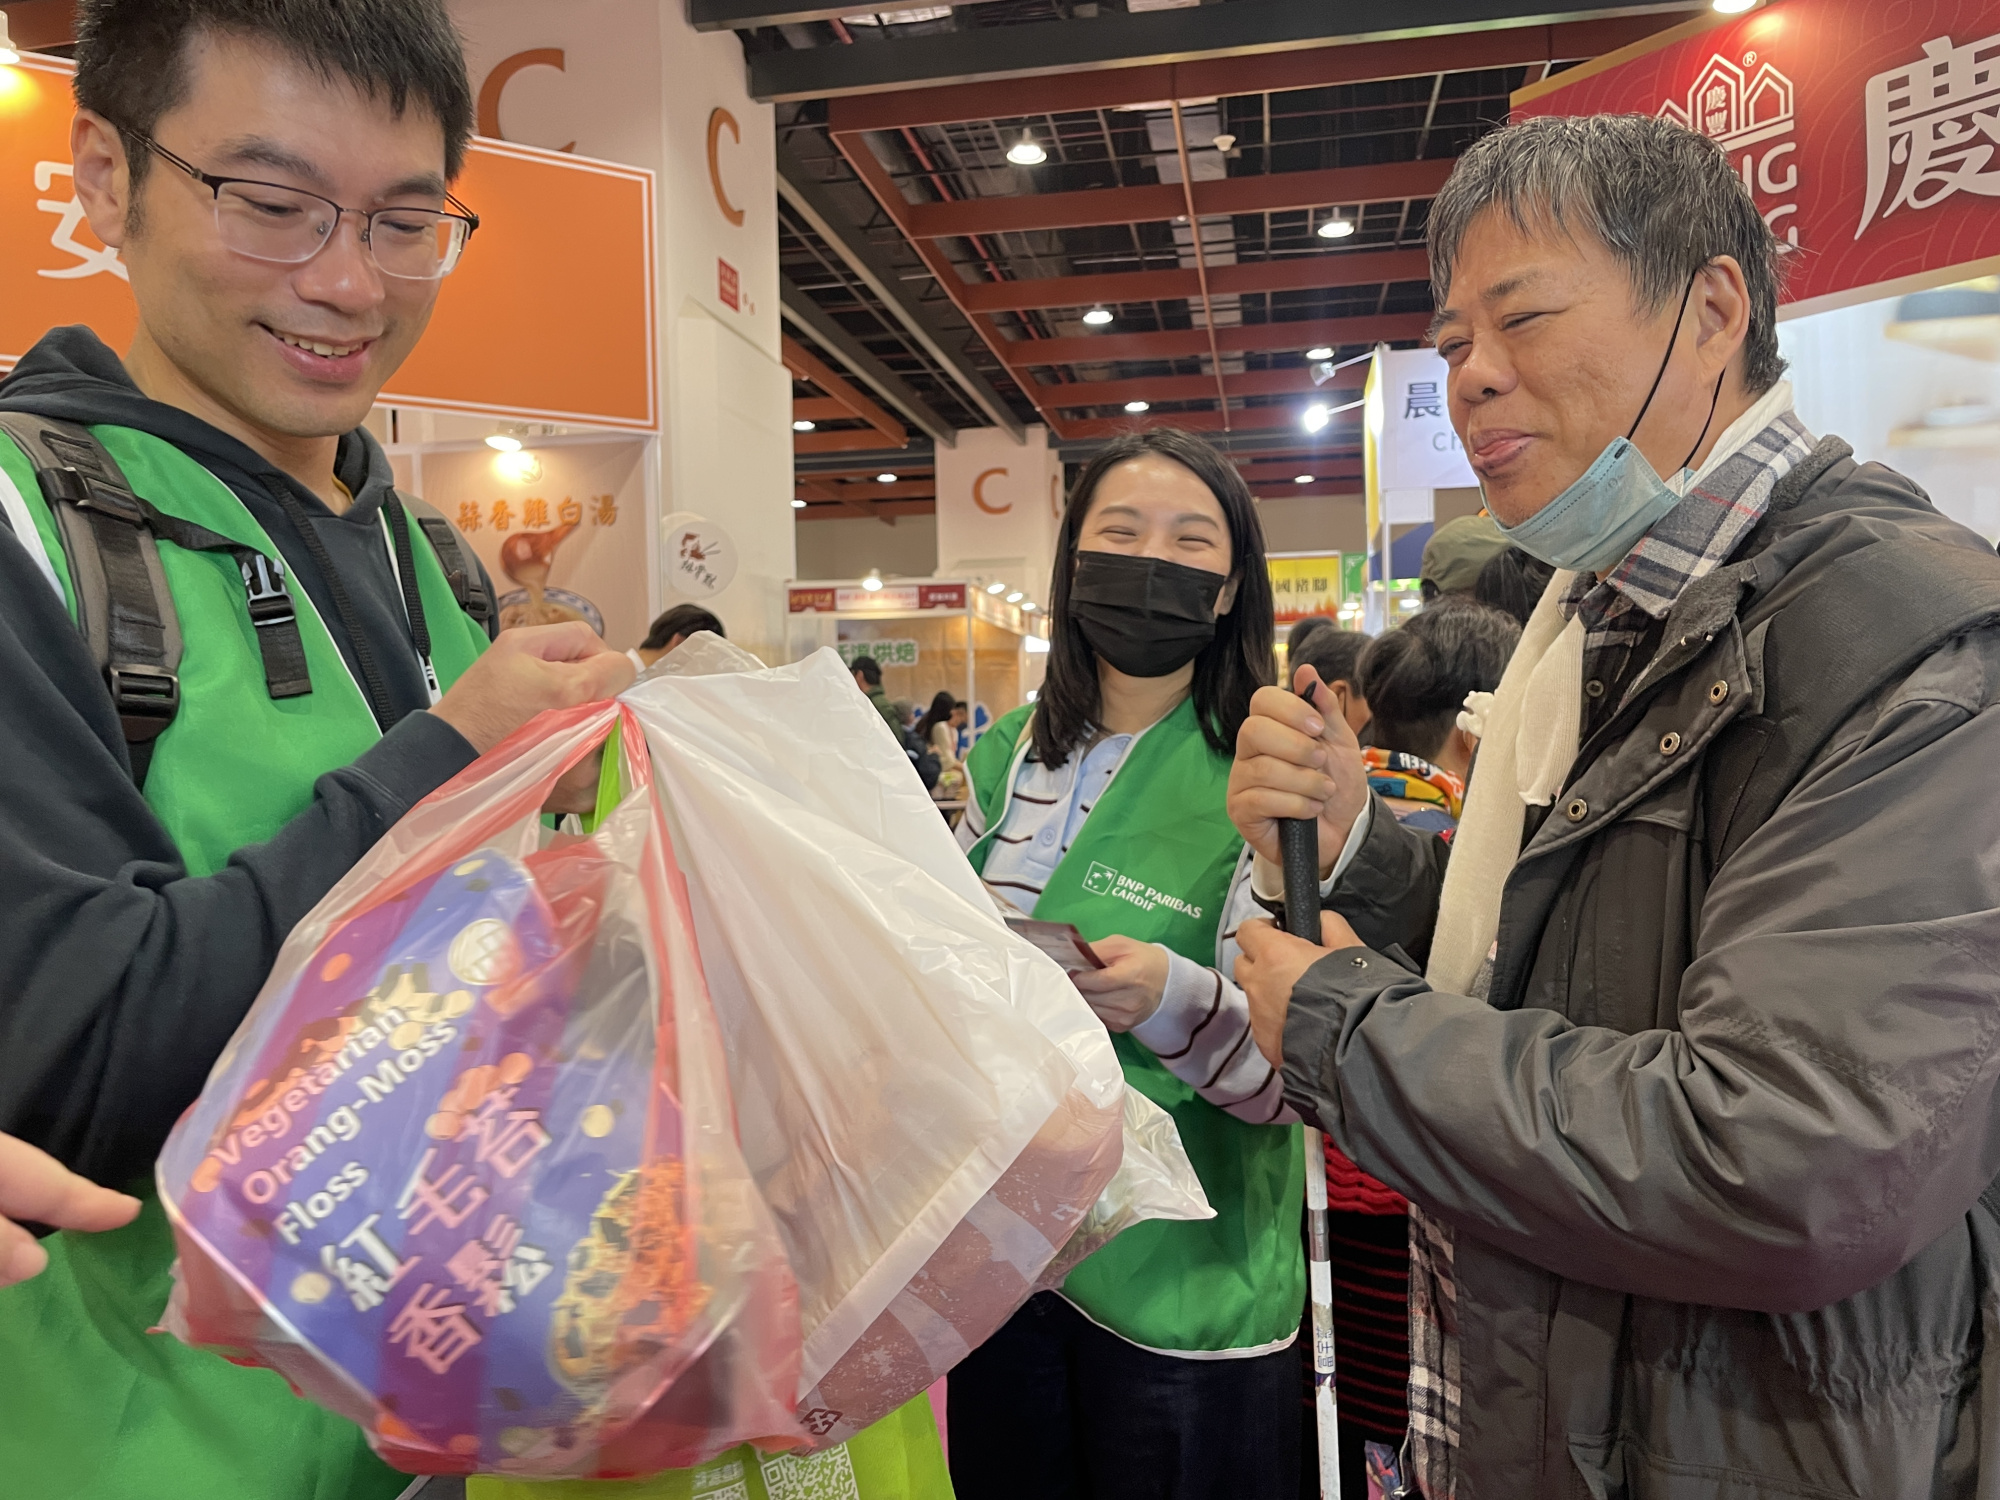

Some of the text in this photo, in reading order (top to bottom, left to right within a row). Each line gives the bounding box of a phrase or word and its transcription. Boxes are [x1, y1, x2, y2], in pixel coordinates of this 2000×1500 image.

[477, 46, 576, 154] C
[1854, 35, 2000, 241] 慶
[706, 106, 746, 228] C
[1404, 381, 1442, 420] 晨
[972, 467, 1013, 516] C
[1111, 886, 1156, 912] CARDIF
[1116, 874, 1203, 919] BNP PARIBAS
[211, 1004, 408, 1168] Vegetarian
[242, 1020, 458, 1206] Orang-Moss
[272, 1161, 370, 1245] Floss
[320, 1085, 552, 1313] 紅毛苔
